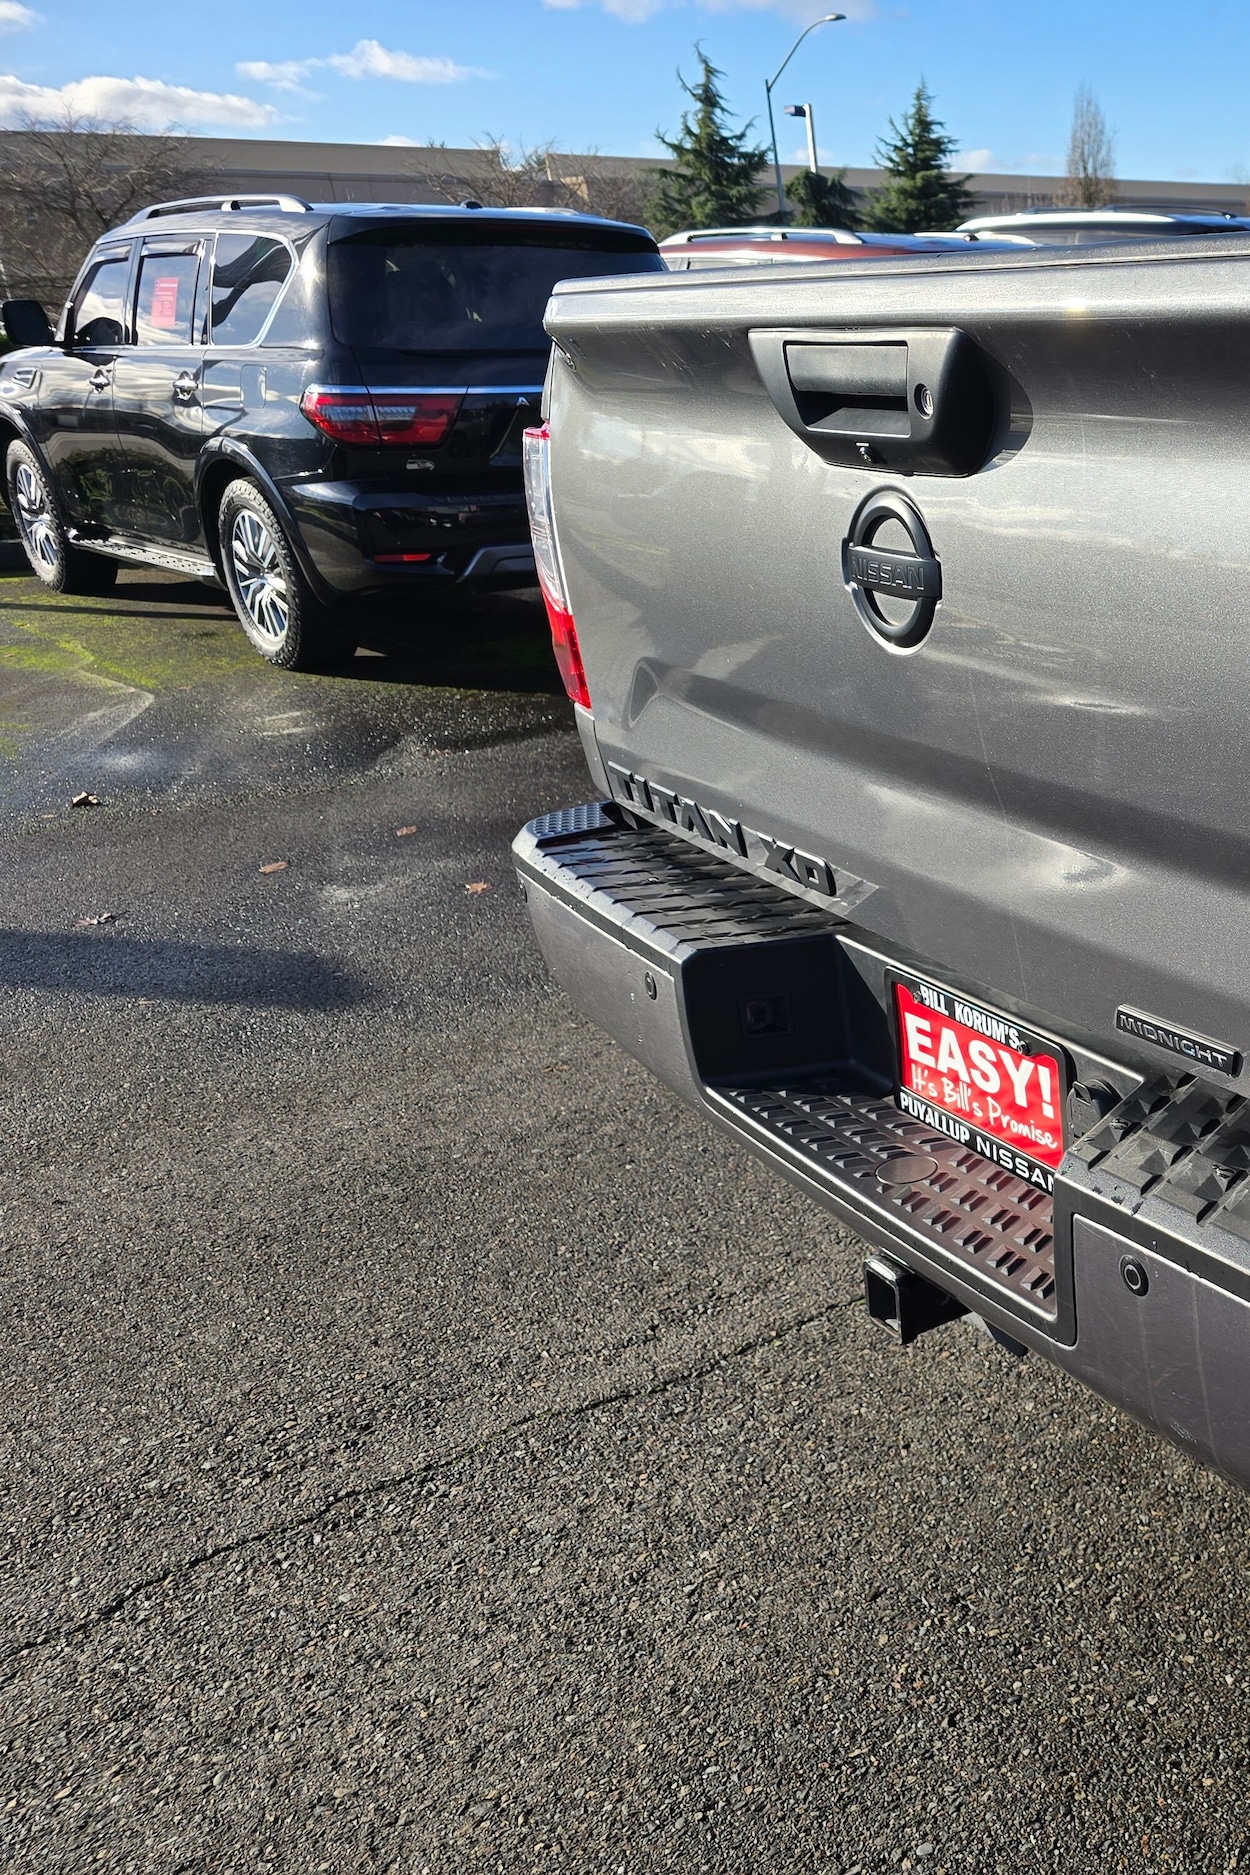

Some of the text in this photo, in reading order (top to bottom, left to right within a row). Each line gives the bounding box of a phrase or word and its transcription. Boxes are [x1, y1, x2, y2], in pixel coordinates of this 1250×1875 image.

[851, 556, 926, 591] NISSAN
[608, 761, 838, 896] TITAN XD
[919, 984, 1021, 1050] BILL KORUM'S
[1118, 1014, 1229, 1069] MIDNIGHT
[904, 1012, 1055, 1119] EASY!
[900, 1092, 970, 1144] PUYALLUP
[911, 1063, 1058, 1149] It's Bill's Promise
